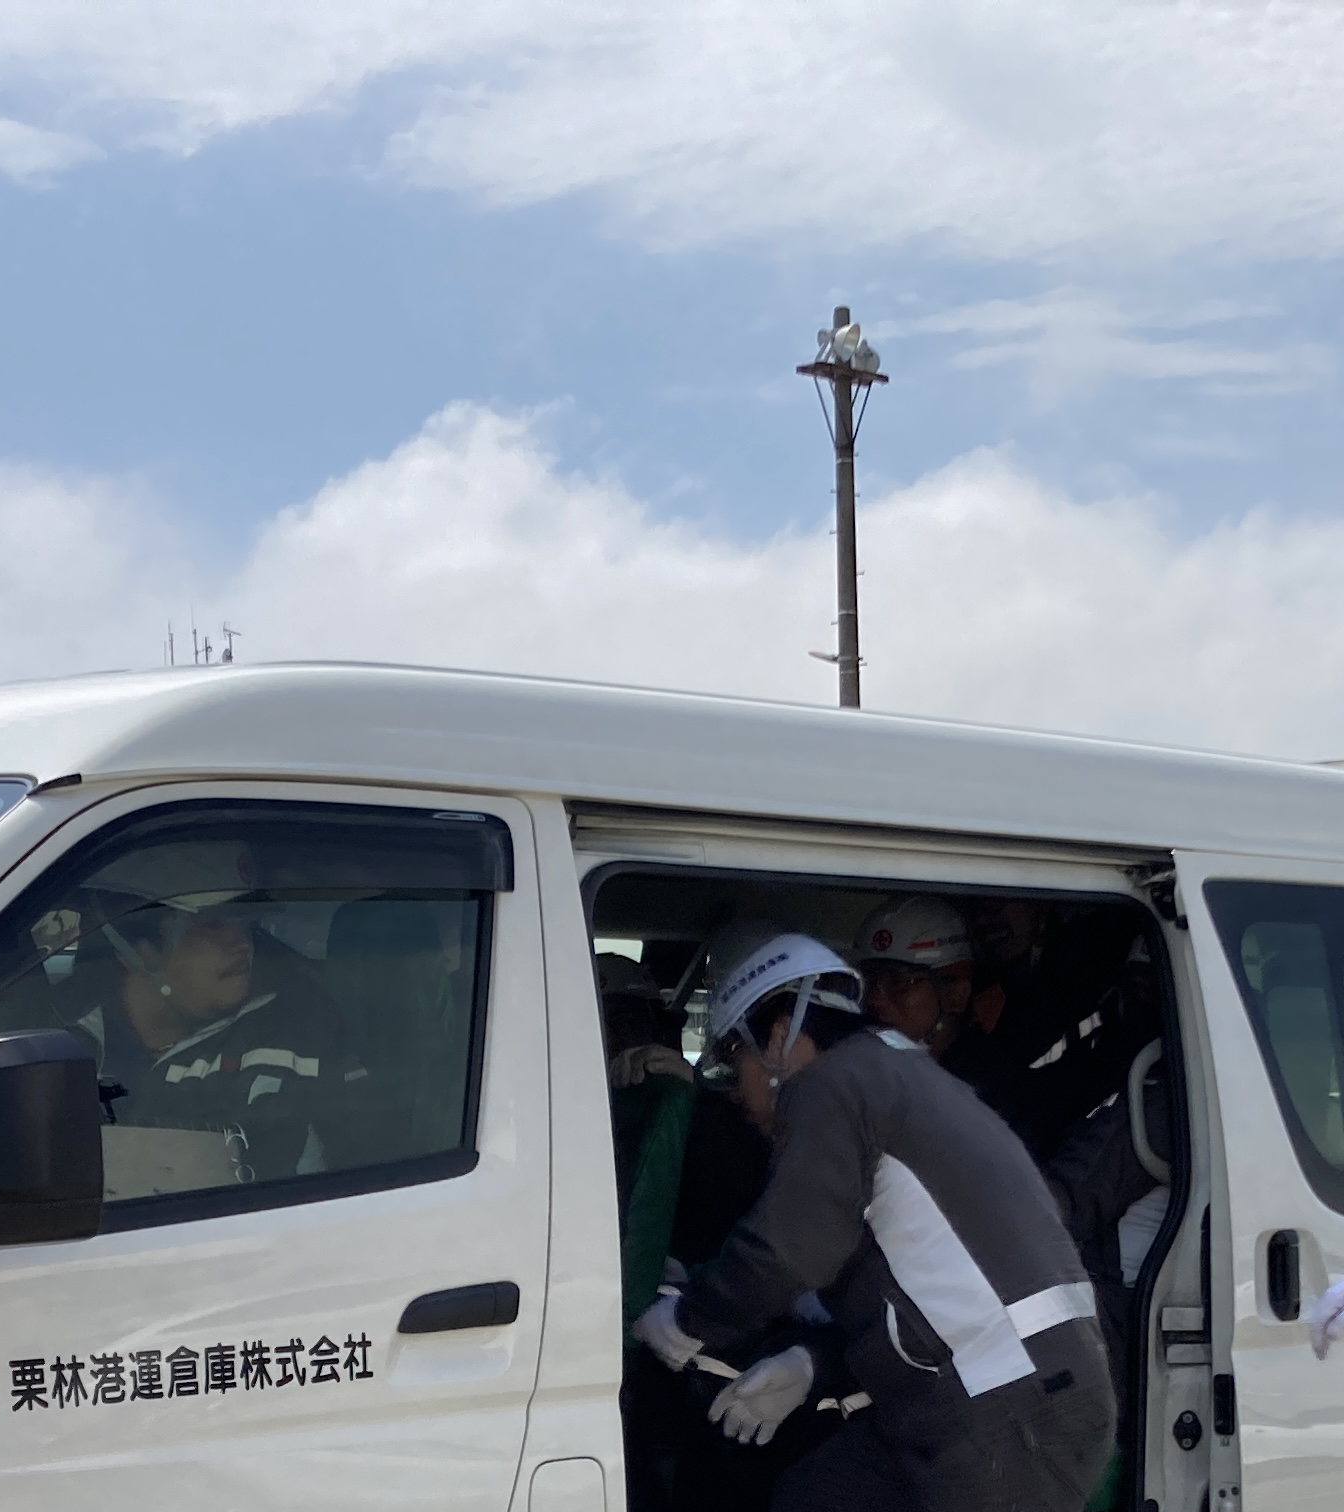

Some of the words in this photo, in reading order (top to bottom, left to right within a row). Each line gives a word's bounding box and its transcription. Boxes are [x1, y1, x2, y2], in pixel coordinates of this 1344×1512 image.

[8, 1332, 375, 1412] 栗林港運倉庫株式会社
